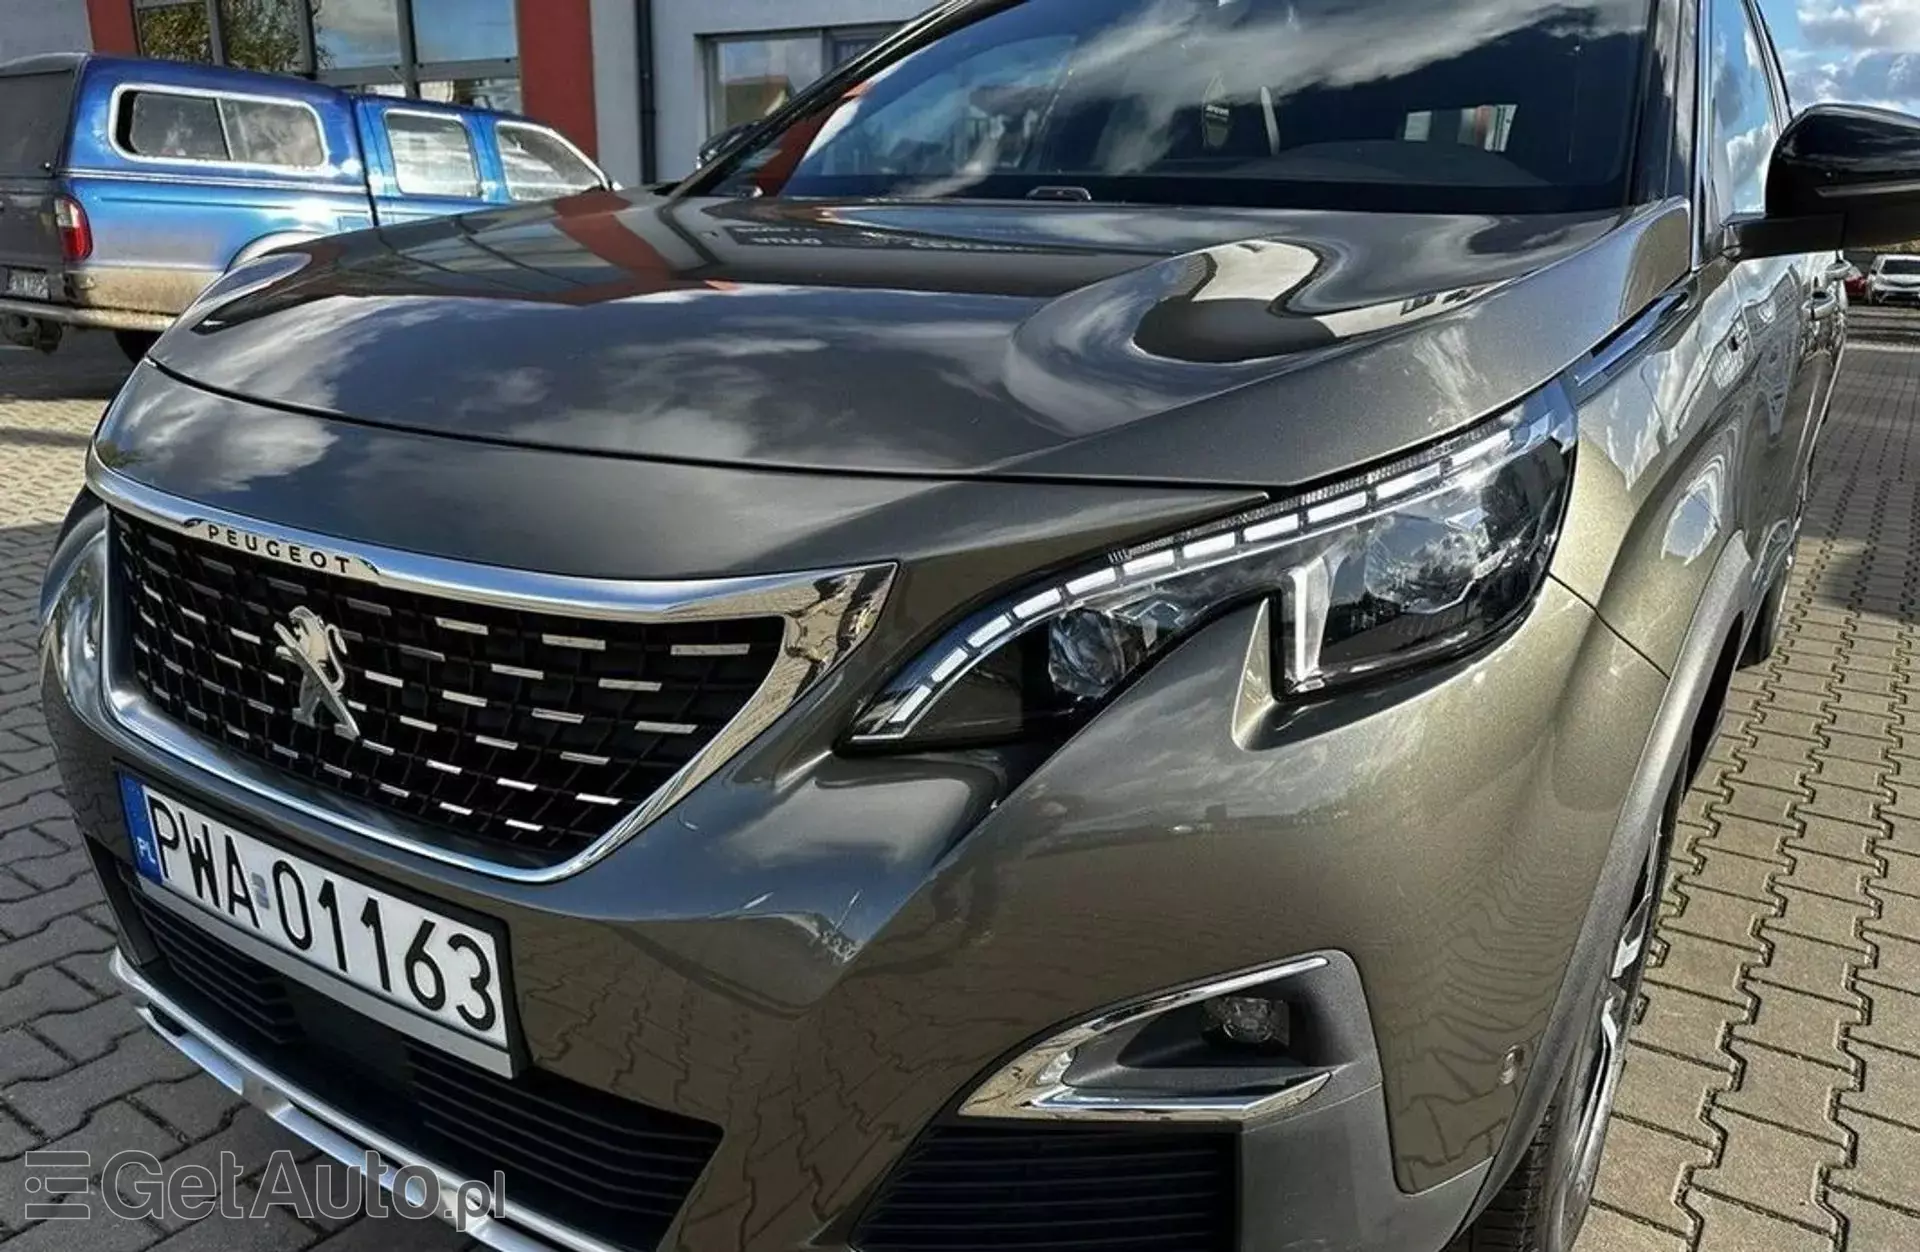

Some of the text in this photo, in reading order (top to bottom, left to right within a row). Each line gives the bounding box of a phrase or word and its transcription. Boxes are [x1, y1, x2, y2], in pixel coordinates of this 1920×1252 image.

[207, 523, 350, 574] PEUGEOT
[148, 795, 496, 1031] PWA 01163
